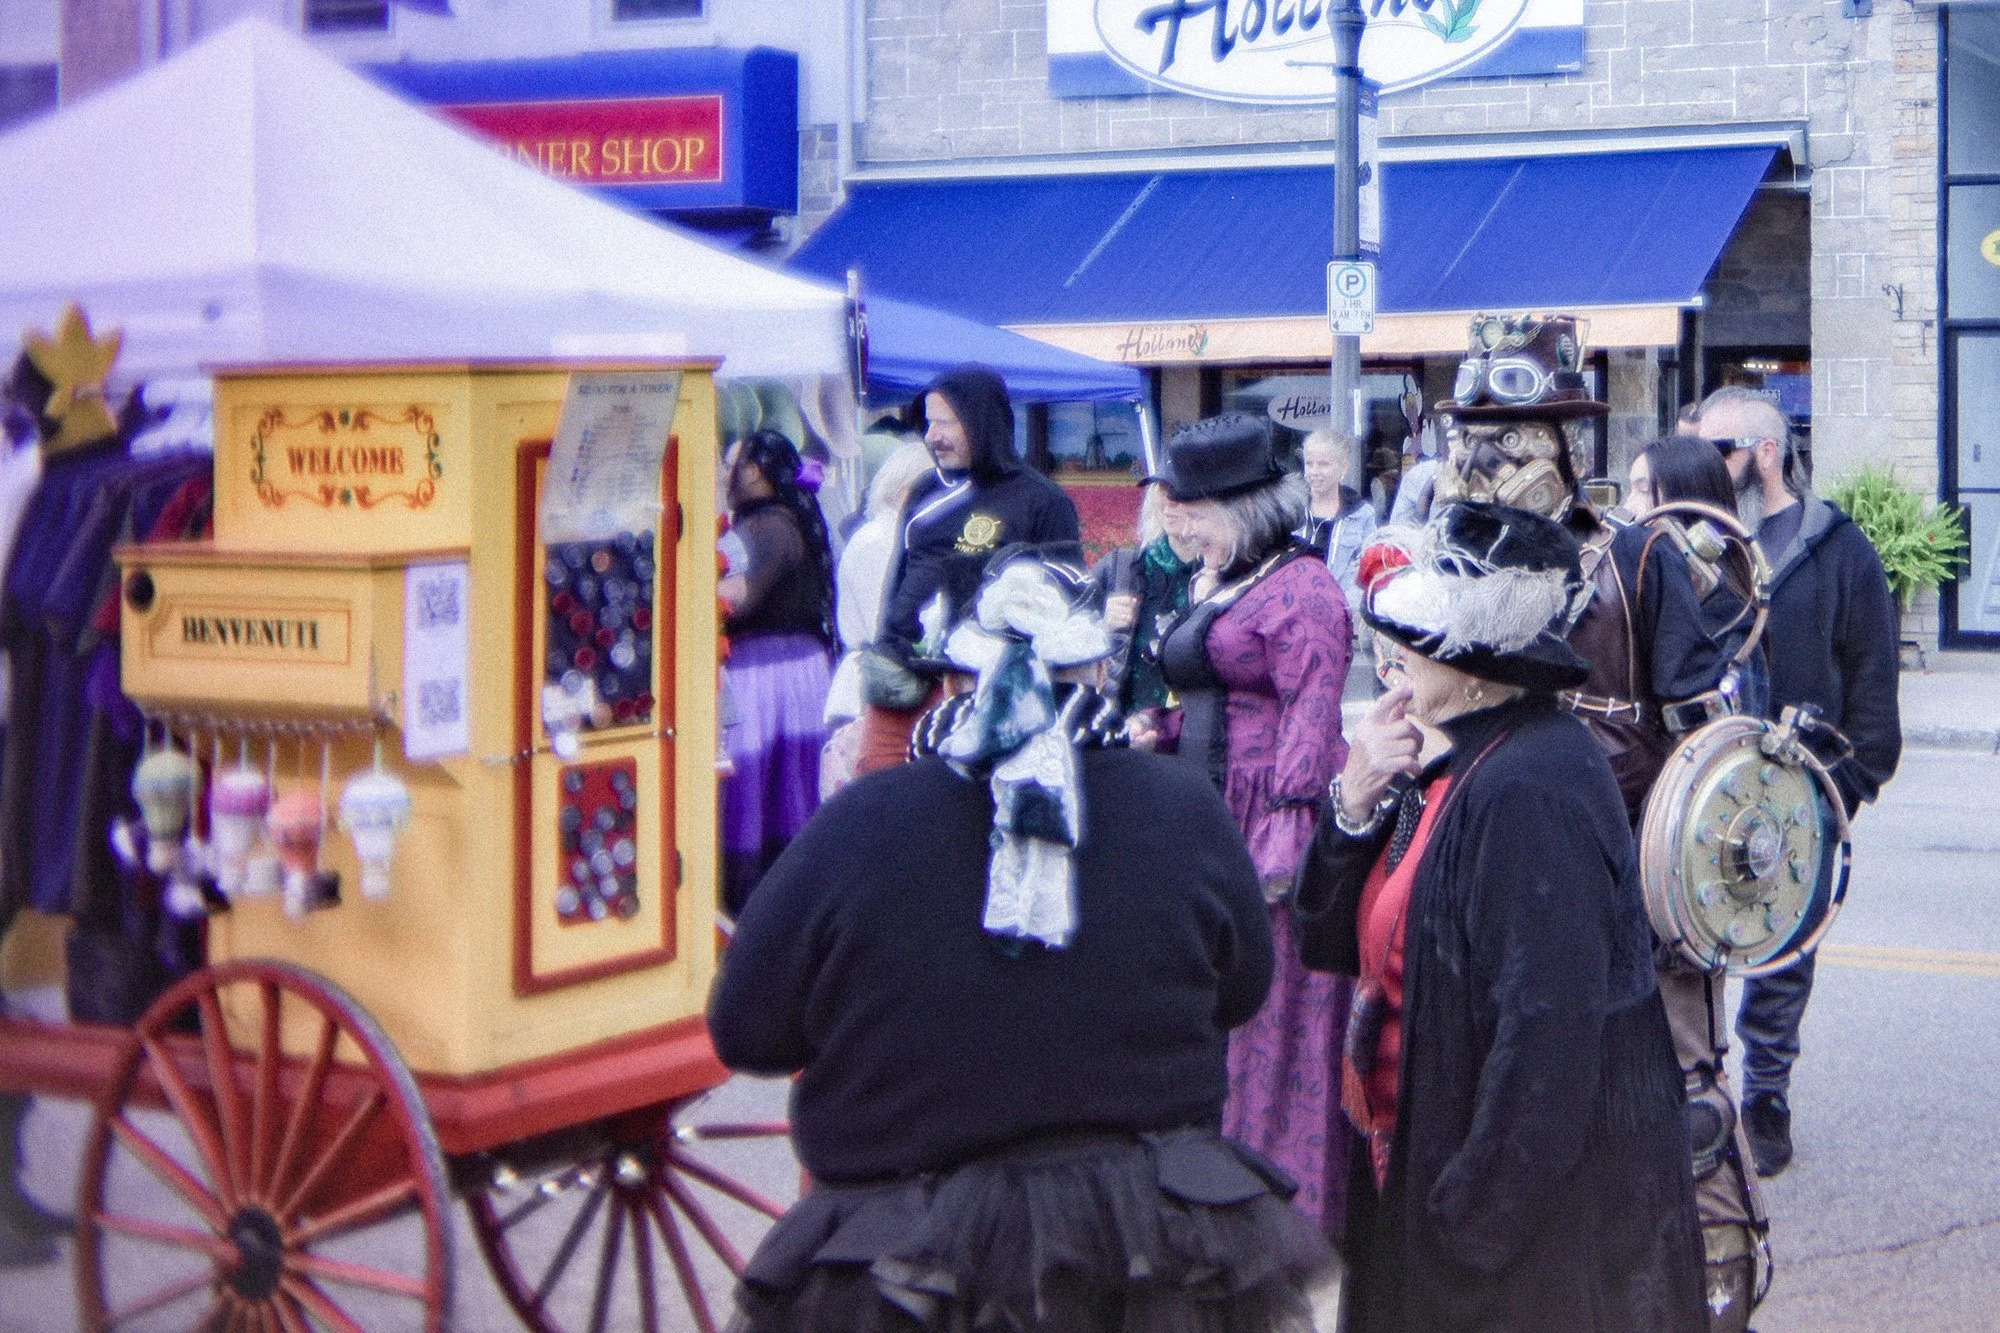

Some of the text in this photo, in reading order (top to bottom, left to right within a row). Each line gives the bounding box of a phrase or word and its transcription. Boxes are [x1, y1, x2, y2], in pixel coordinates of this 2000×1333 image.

[601, 138, 705, 176] SHOP
[1346, 275, 1360, 291] P
[1339, 310, 1350, 319] AM
[1360, 310, 1371, 319] PM
[1341, 299, 1362, 309] 3 HR
[1277, 396, 1332, 421] Hollan
[287, 447, 404, 475] WELCOME
[182, 616, 319, 649] BENVENUTI
